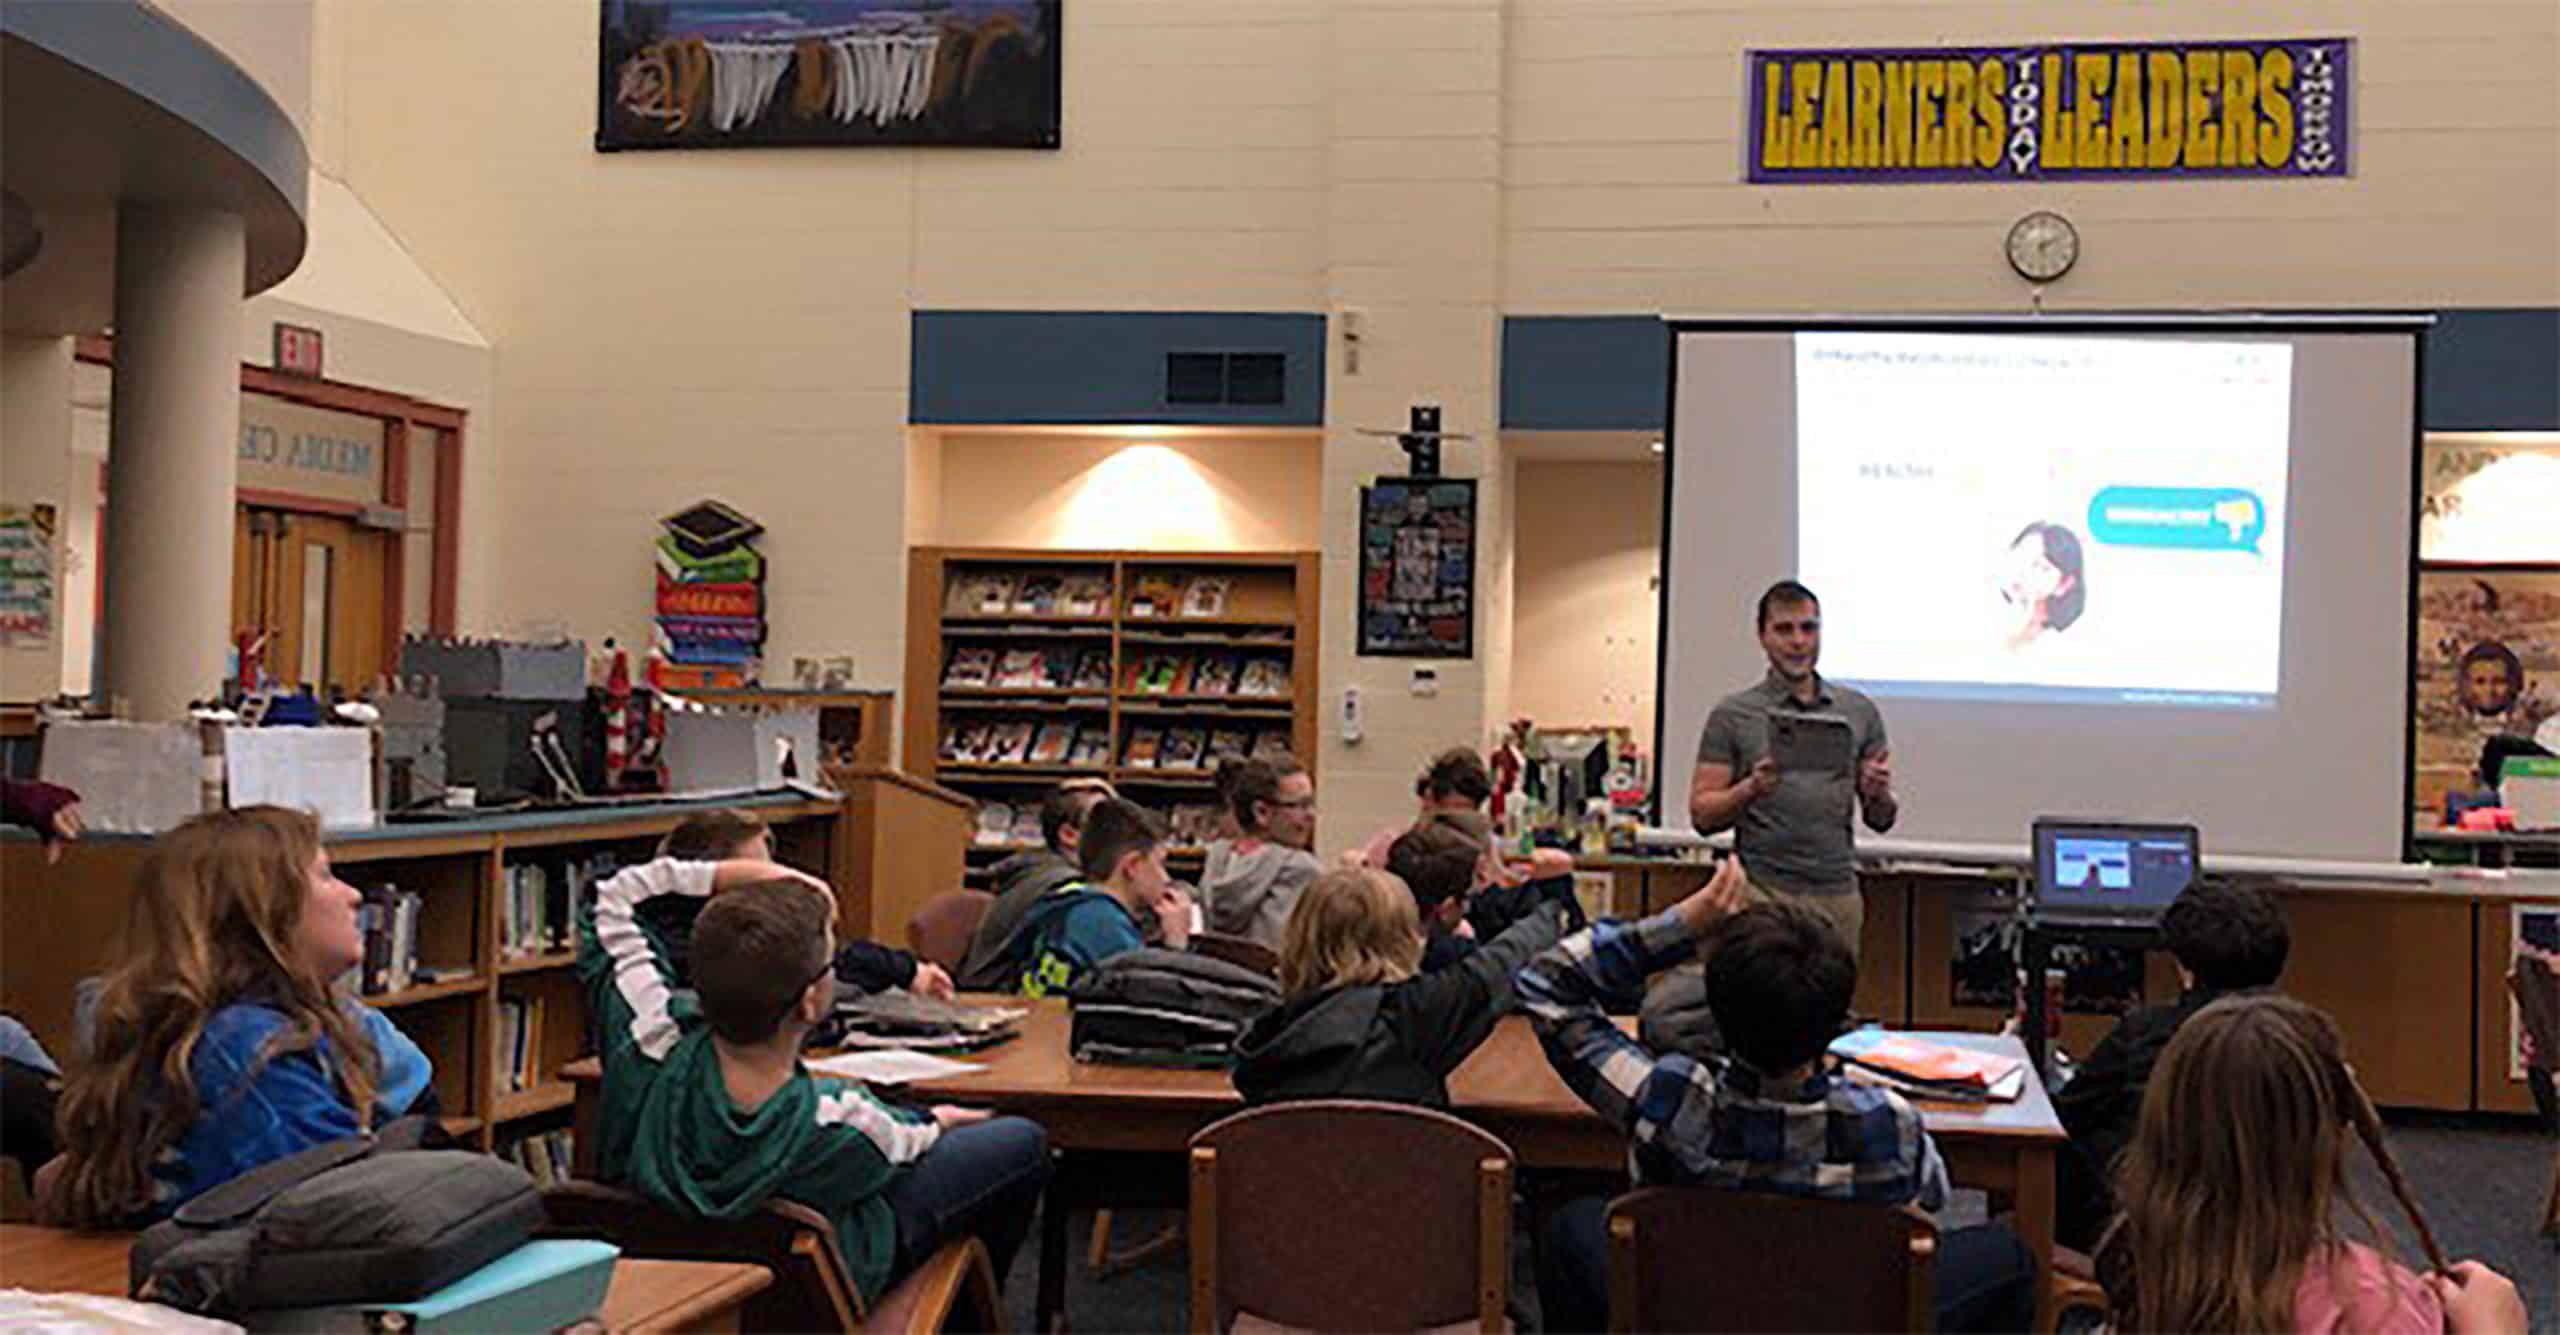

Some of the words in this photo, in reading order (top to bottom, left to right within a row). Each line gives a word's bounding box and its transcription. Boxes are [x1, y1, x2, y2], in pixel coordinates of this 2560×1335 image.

[1761, 55, 2005, 169] LEARNERS
[2009, 56, 2040, 175] TODAY
[2039, 47, 2296, 169] LEADERS
[2297, 47, 2336, 171] TOMORROW
